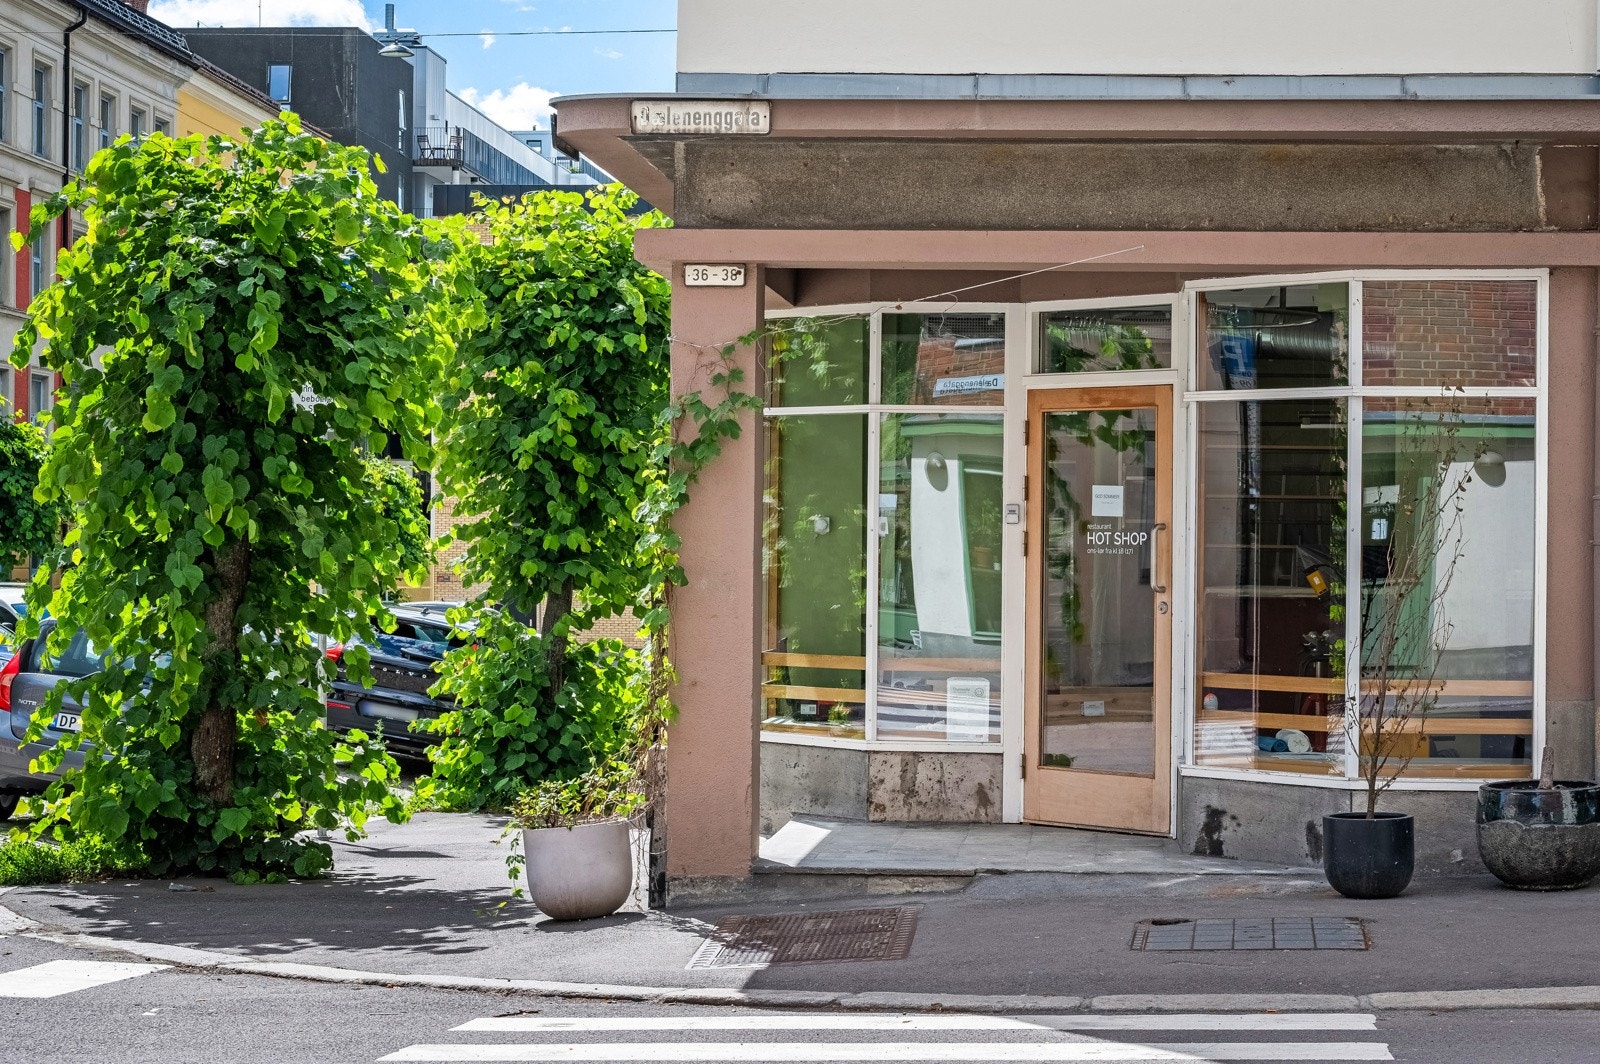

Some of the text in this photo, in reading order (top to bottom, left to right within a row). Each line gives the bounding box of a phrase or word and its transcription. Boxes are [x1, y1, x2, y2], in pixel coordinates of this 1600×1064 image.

[1086, 532, 1147, 545] HOT SHOP
[370, 664, 427, 679] VOLVO
[18, 698, 37, 706] NOTE
